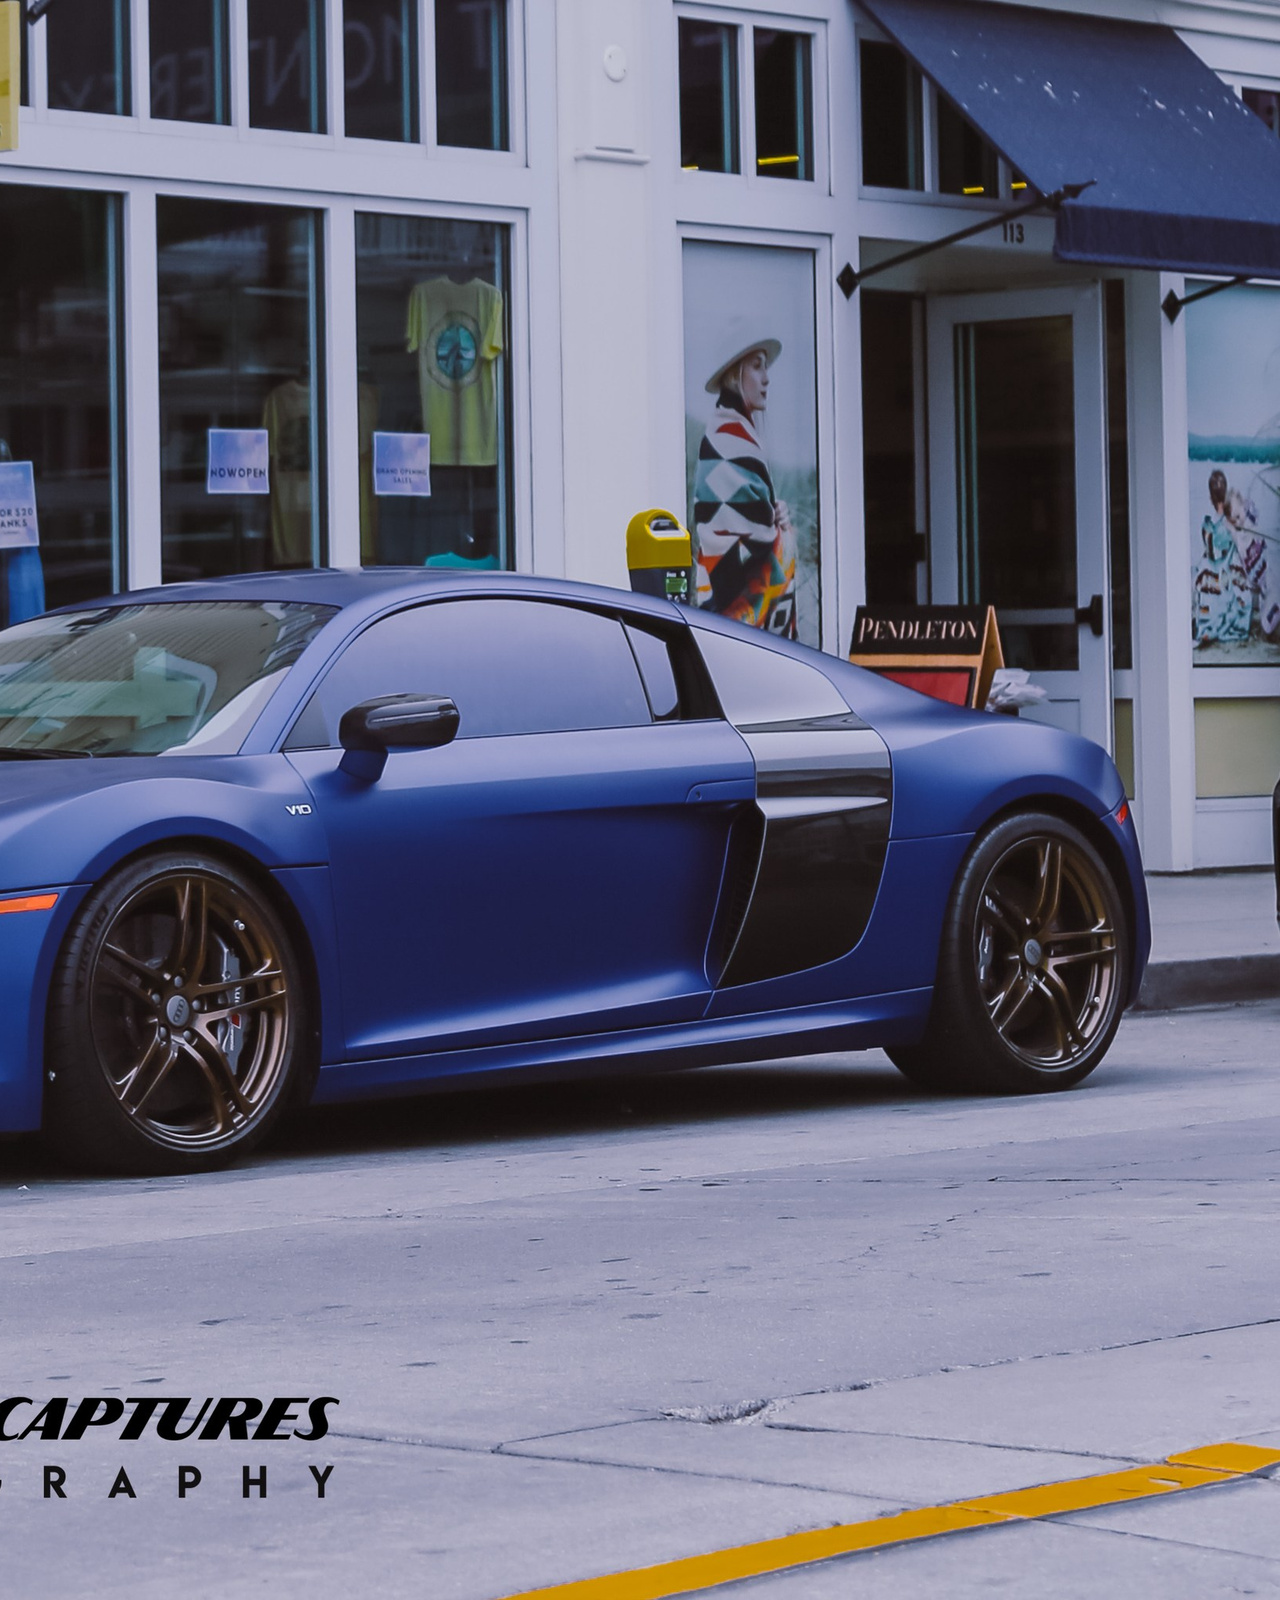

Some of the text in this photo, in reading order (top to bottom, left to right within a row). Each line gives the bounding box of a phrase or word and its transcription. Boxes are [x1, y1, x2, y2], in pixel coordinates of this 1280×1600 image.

[1002, 222, 1025, 244] 113
[858, 617, 979, 643] PENDLETON
[285, 805, 311, 815] V10
